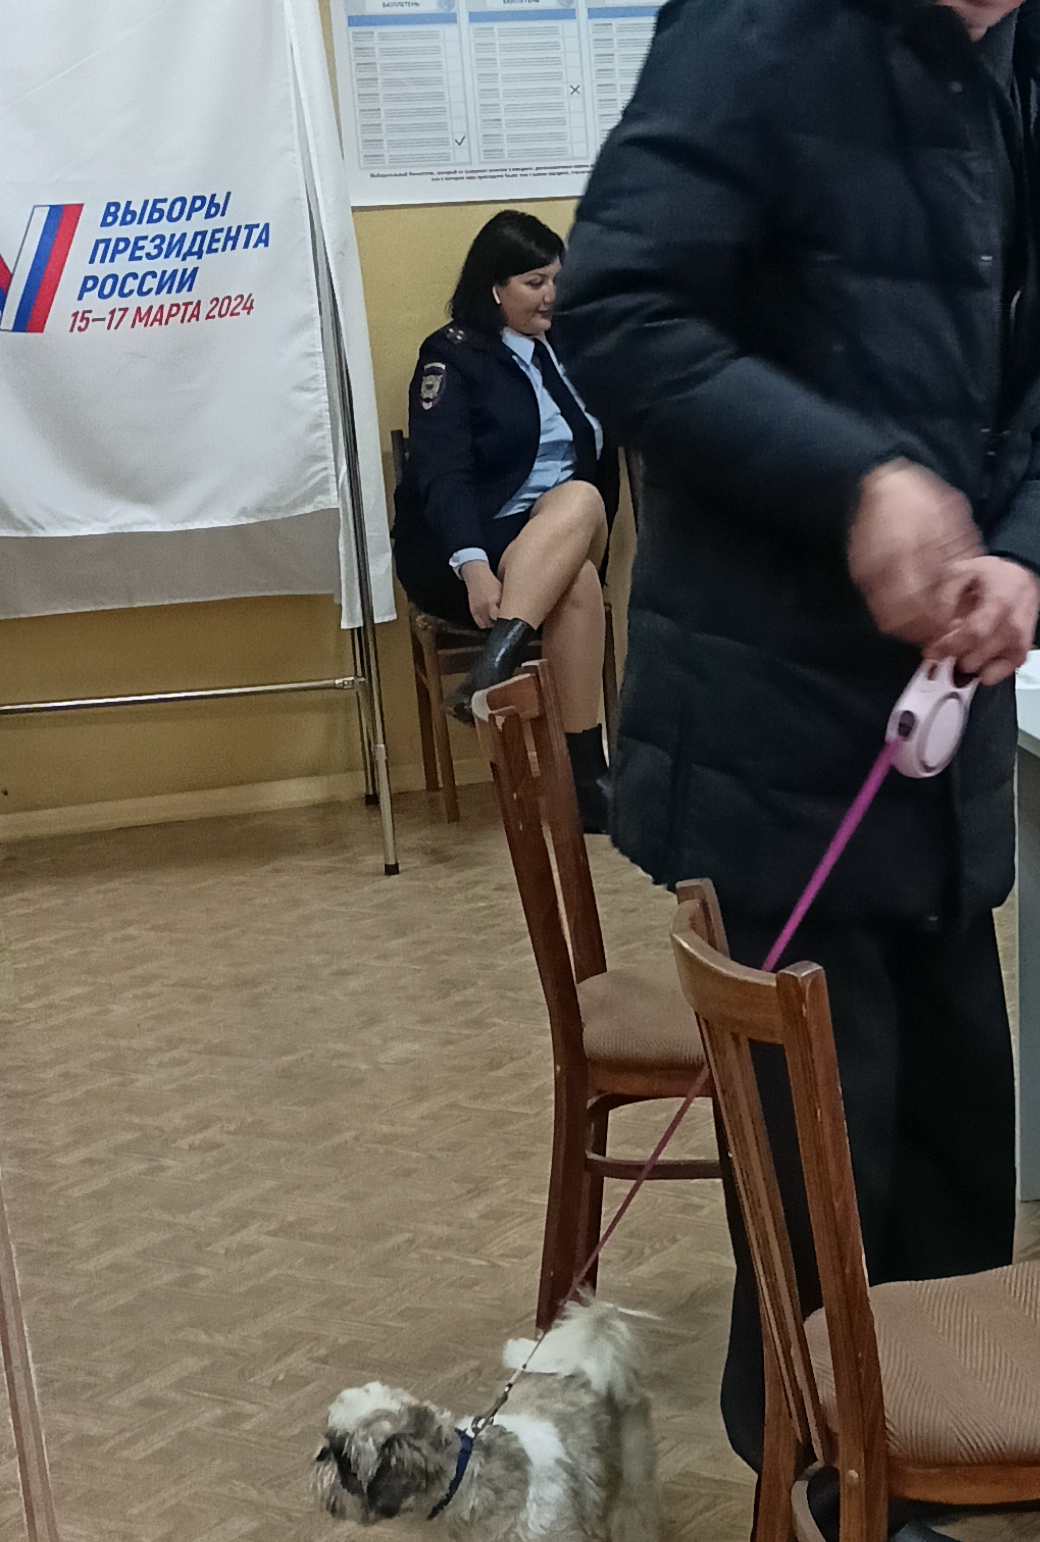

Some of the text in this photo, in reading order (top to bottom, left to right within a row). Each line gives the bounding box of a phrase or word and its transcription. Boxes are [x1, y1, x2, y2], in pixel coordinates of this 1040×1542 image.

[100, 191, 232, 228] ВЫБОРЫ
[88, 222, 271, 265] ПРЕЗИДЕНТА
[77, 267, 199, 301] РОССИИ
[131, 299, 201, 329] МАРТА
[205, 293, 255, 321] 2024
